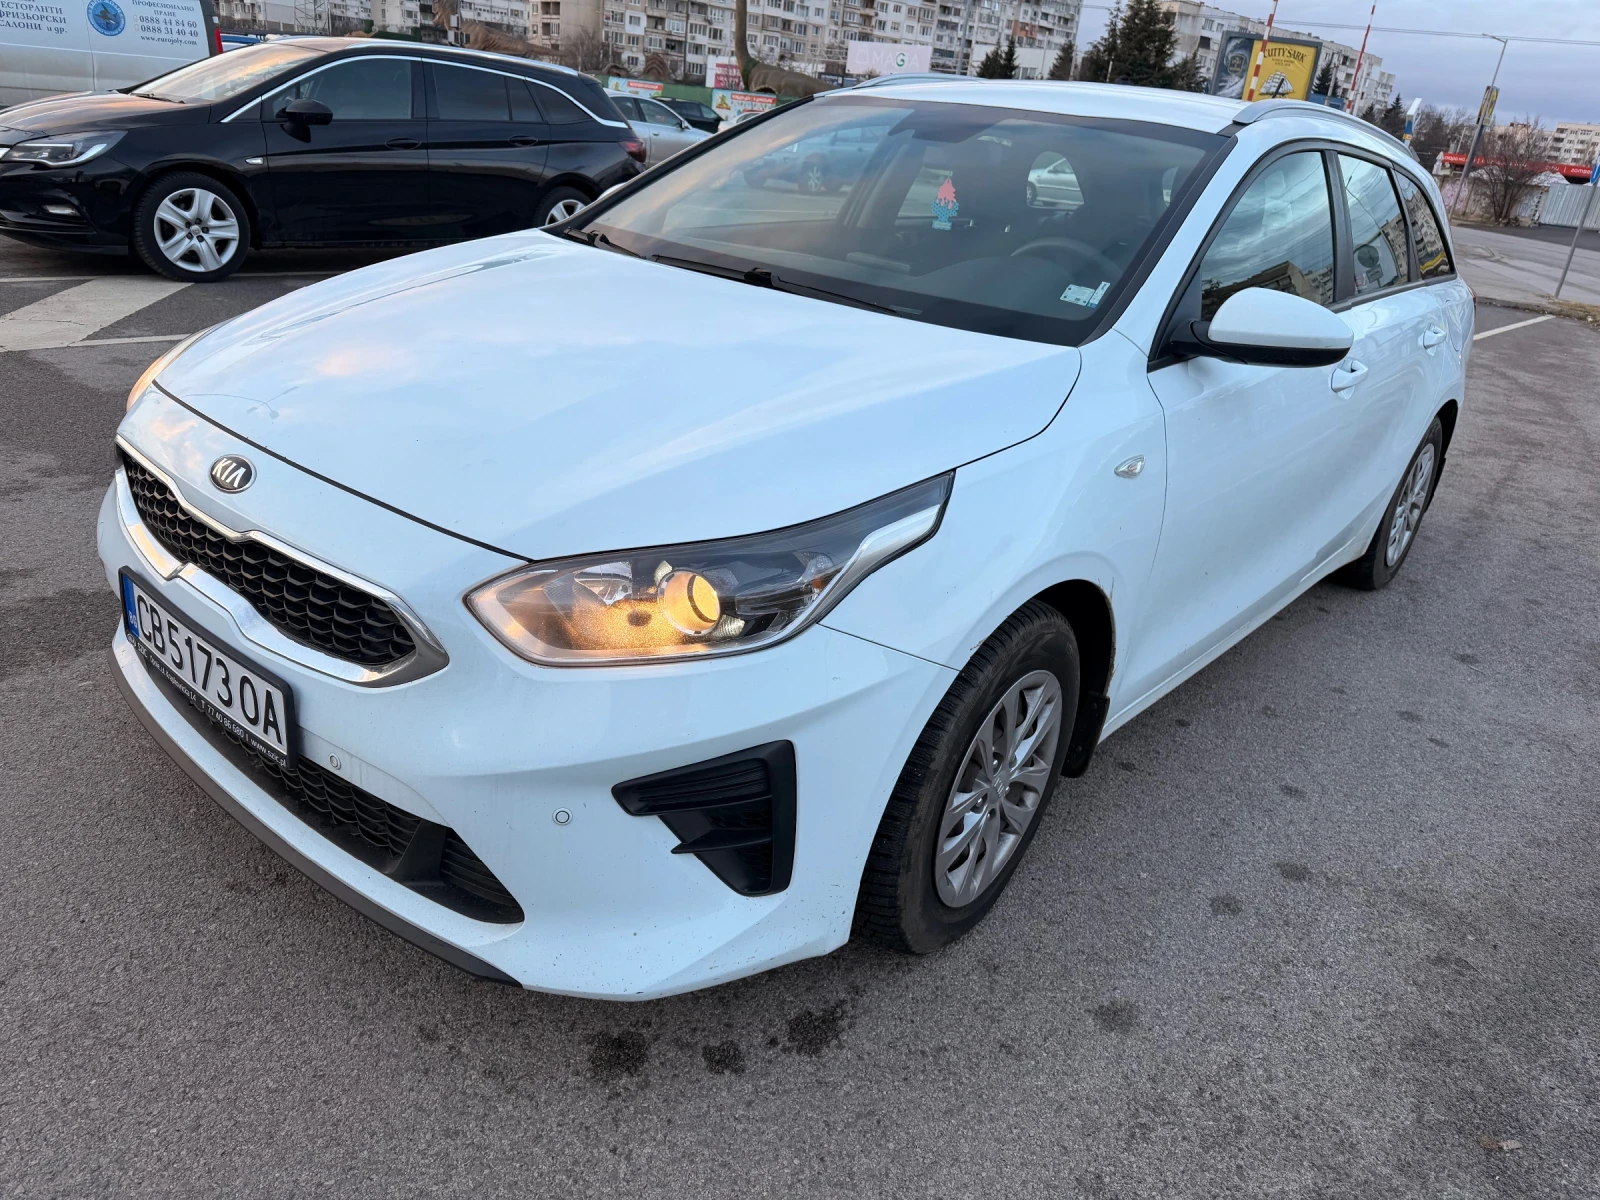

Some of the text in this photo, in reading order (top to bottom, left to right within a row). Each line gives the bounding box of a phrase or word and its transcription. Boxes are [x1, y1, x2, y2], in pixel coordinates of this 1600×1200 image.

[0, 1, 63, 14] ЕСТОРАНТИ
[153, 9, 177, 17] ПРАНЕ
[139, 15, 197, 28] 0888 44 84 60
[140, 24, 199, 37] 0888 31 40 40
[1286, 48, 1307, 63] SARK
[212, 458, 247, 488] KIA
[201, 700, 206, 709] T
[207, 704, 215, 716] 77
[215, 711, 223, 723] 40
[223, 717, 232, 729] 86
[232, 724, 244, 738] 680
